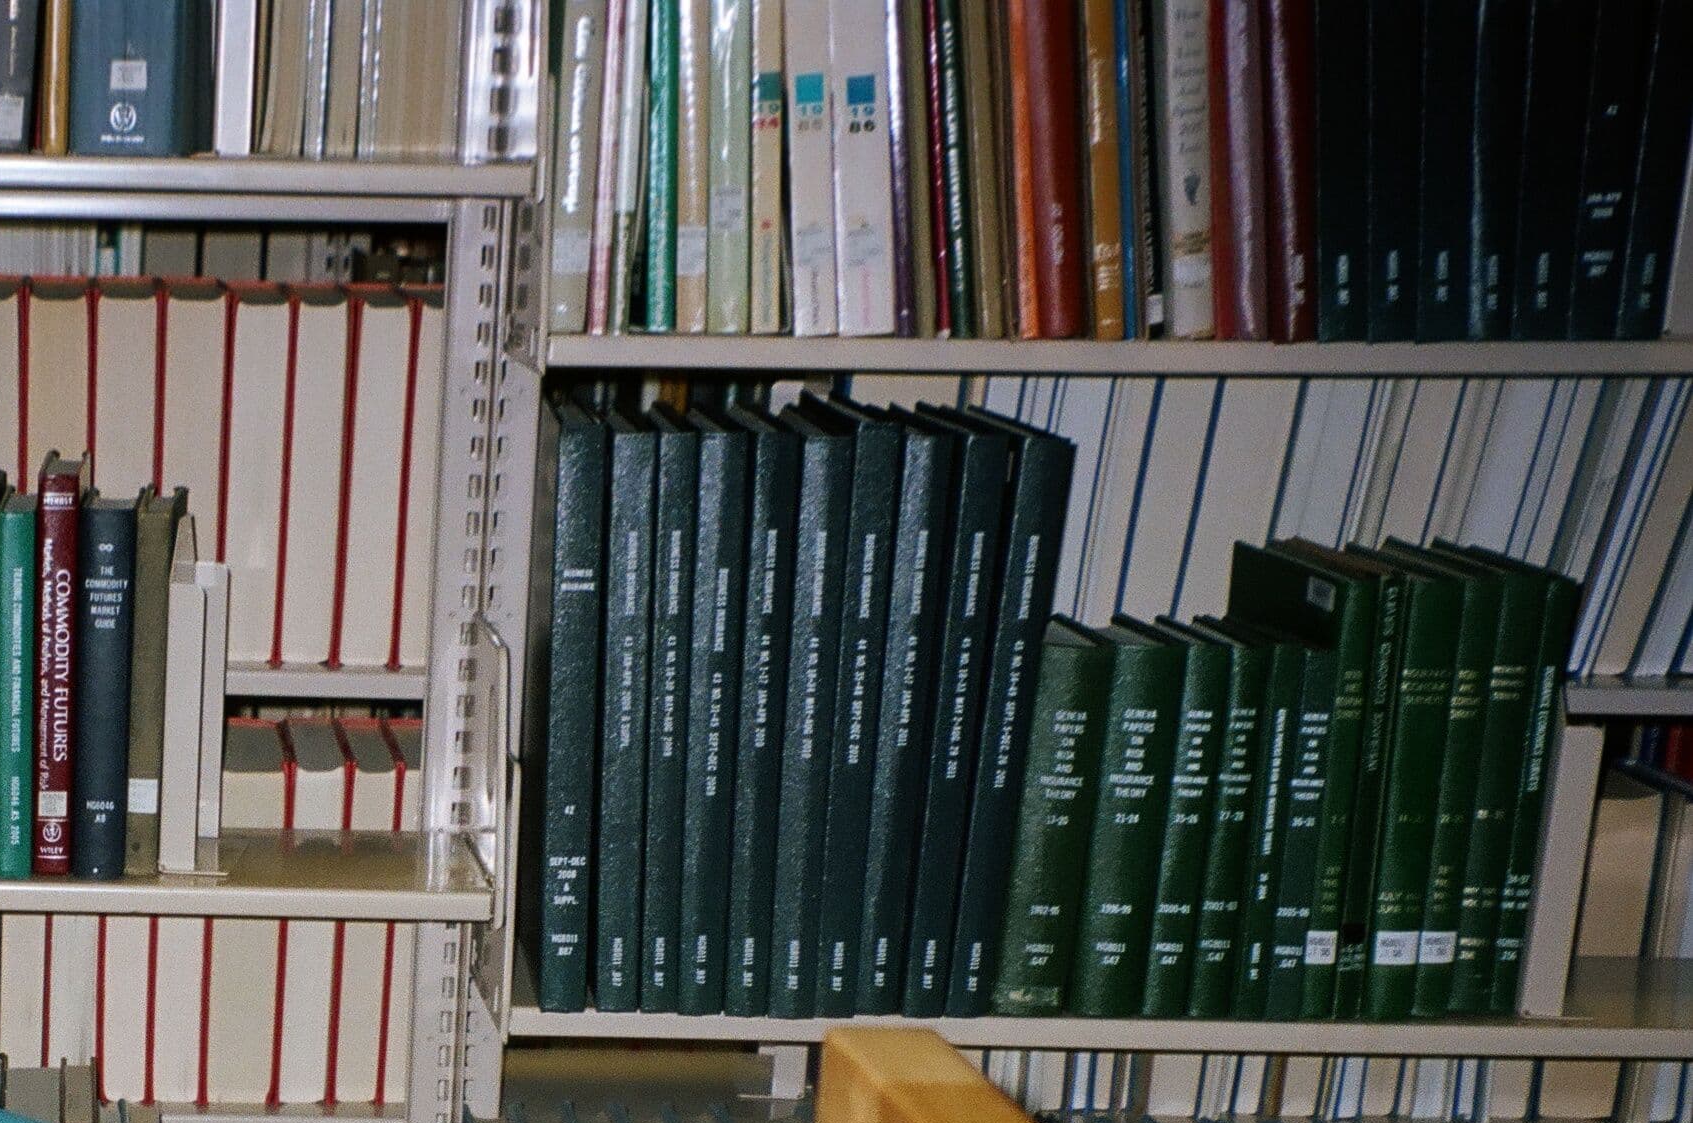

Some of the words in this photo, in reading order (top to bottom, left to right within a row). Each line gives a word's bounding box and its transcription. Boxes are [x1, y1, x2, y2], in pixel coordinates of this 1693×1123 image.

[42, 538, 54, 578] Markets,
[100, 566, 114, 576] THE
[84, 579, 129, 590] COMMODITY
[41, 579, 53, 622] Methods
[89, 592, 123, 603] FUTURES
[90, 606, 121, 616] MARKET
[54, 568, 71, 682] COMMODITY
[94, 619, 117, 630] GUIDE
[40, 634, 52, 676] Analysis,
[11, 658, 22, 675] AND
[11, 676, 22, 717] FINANCIAL
[40, 678, 50, 697] and
[39, 699, 50, 758] Management
[53, 686, 69, 762] FUTURES
[10, 718, 21, 753] FUTURES
[1109, 773, 1155, 786] INSURANCE
[1113, 786, 1148, 798] THEORY
[39, 846, 64, 856] WILEY
